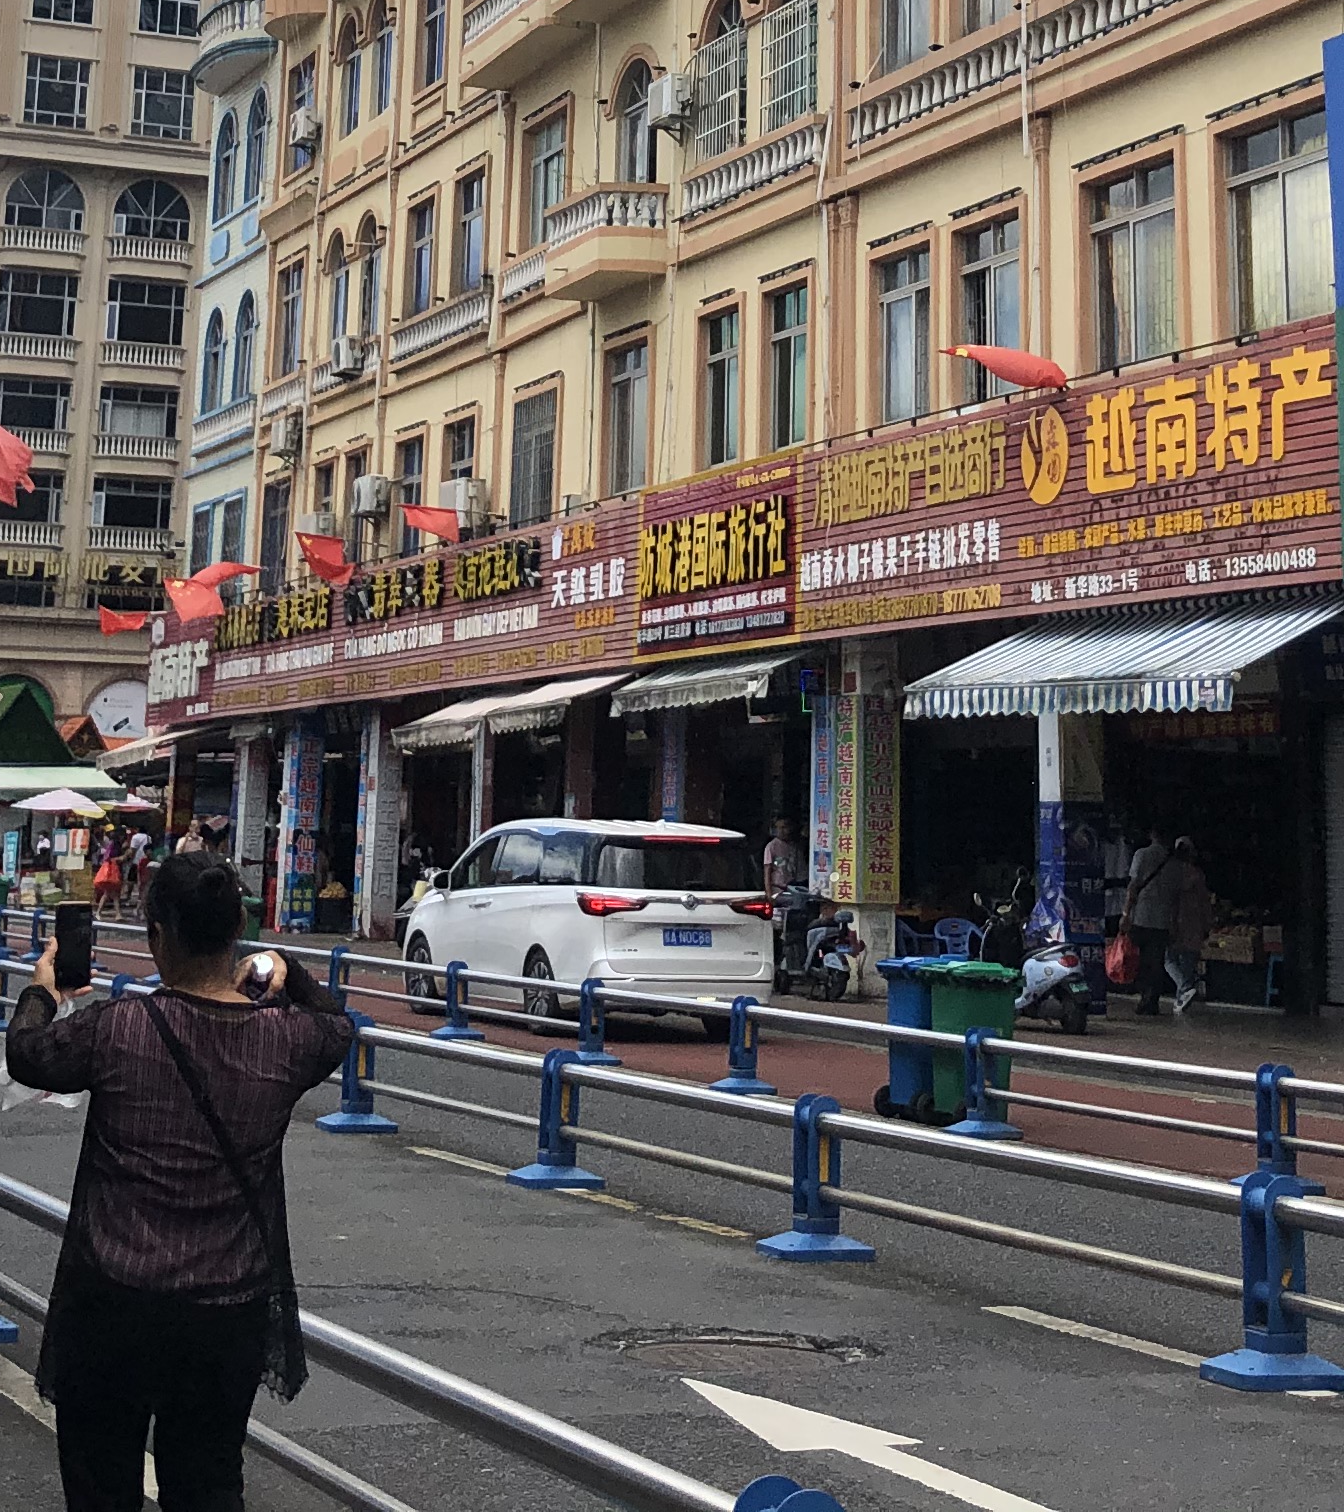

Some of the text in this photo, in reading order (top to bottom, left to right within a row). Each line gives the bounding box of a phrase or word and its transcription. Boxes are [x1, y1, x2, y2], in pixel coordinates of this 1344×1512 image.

[1086, 345, 1333, 495] 越南特产
[551, 556, 626, 609] 天然乳胶
[639, 494, 787, 599] 防城港国际旅行社
